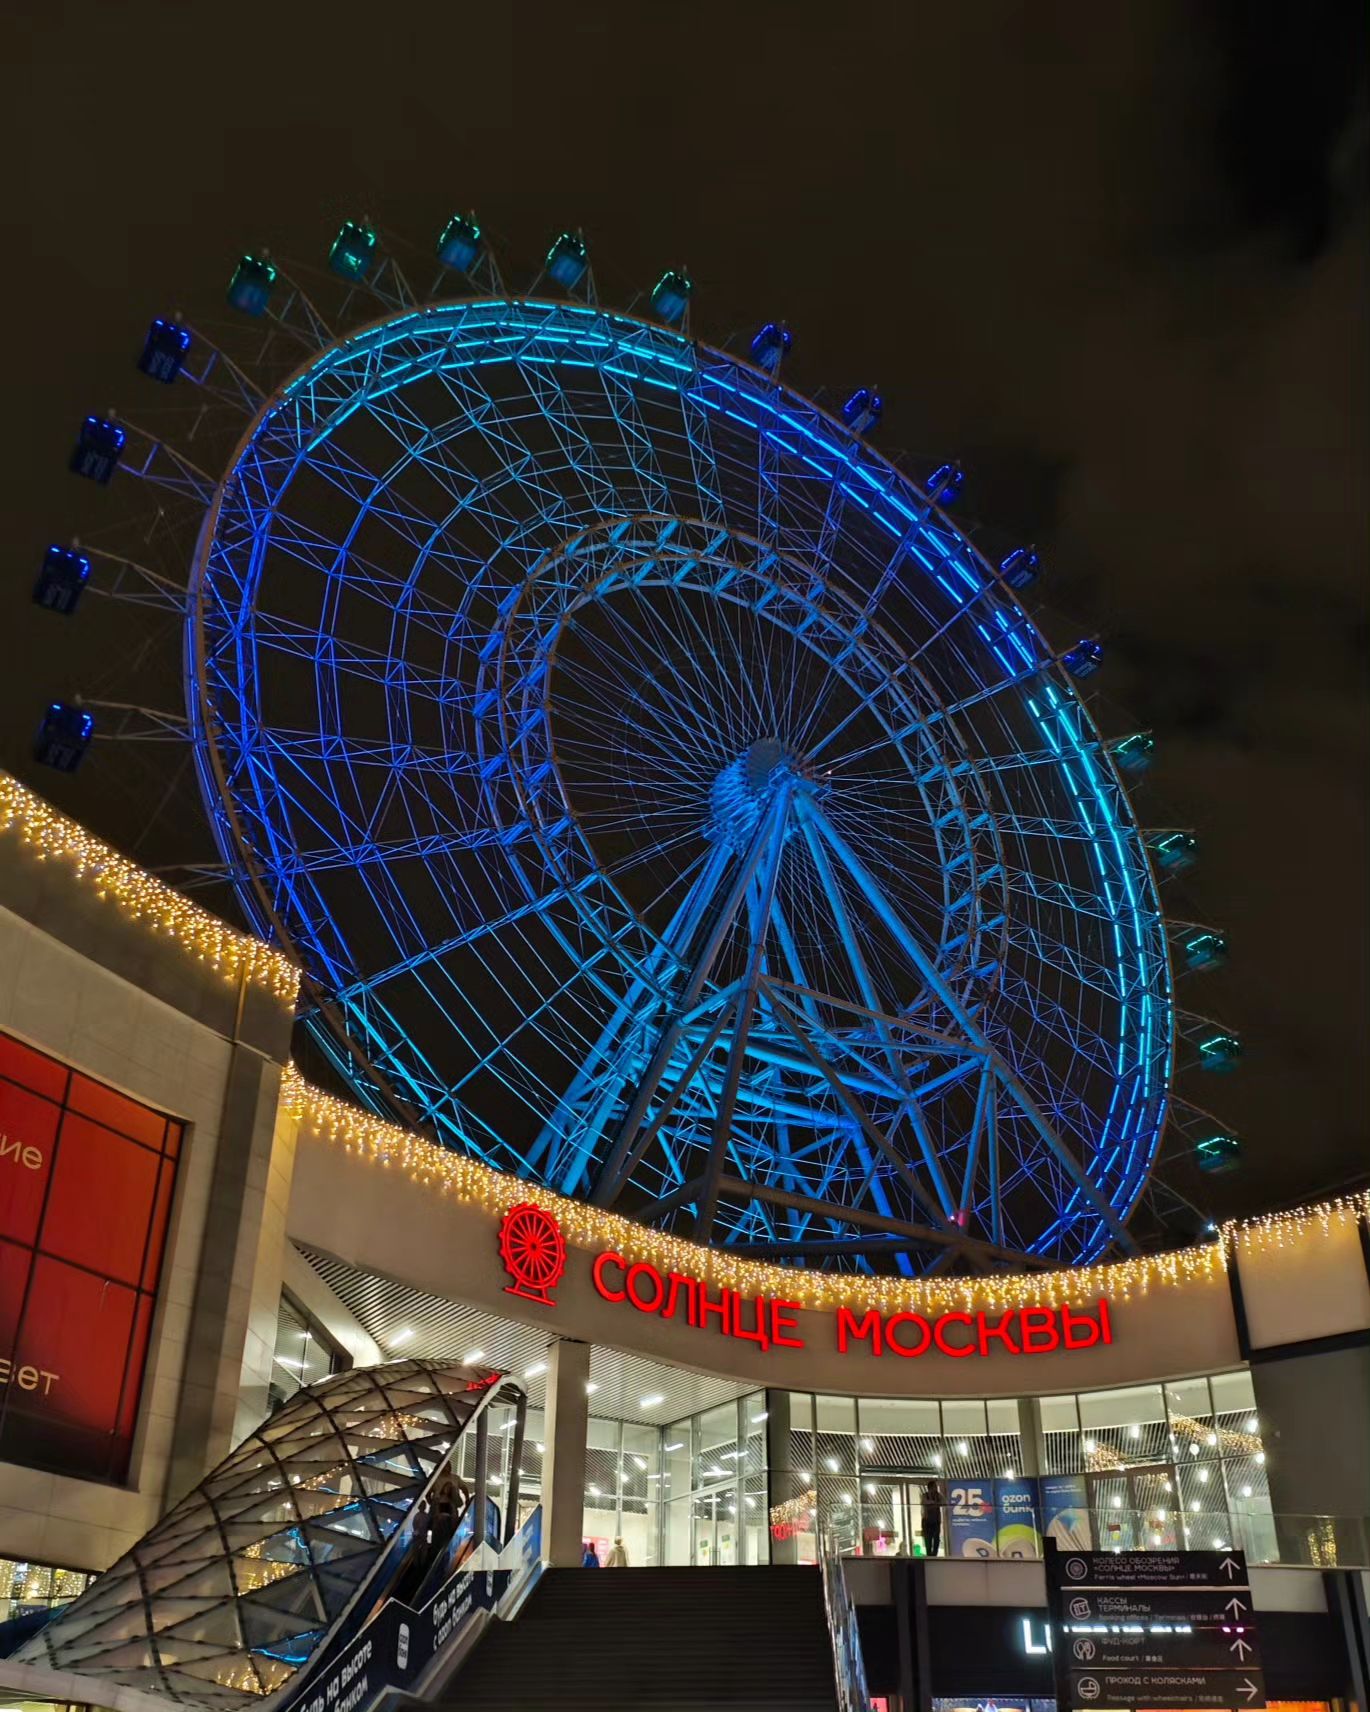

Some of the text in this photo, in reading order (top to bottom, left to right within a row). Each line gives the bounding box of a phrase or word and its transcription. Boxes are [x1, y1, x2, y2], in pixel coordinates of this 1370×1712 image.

[0, 1133, 43, 1170] ие
[592, 1251, 1113, 1358] СОЛНЦЕ МОСКВЫ
[951, 1488, 985, 1517] 25
[1001, 1493, 1031, 1503] ozon
[1097, 1597, 1127, 1605] КАССЫ
[1098, 1604, 1151, 1612] ТЕРМИНАЛЫ
[300, 1695, 325, 1712] дь
[326, 1675, 340, 1705] на
[341, 1640, 373, 1689] высоте
[1105, 1676, 1206, 1685] ПРОХОД С КОЛЯСКАМИ
